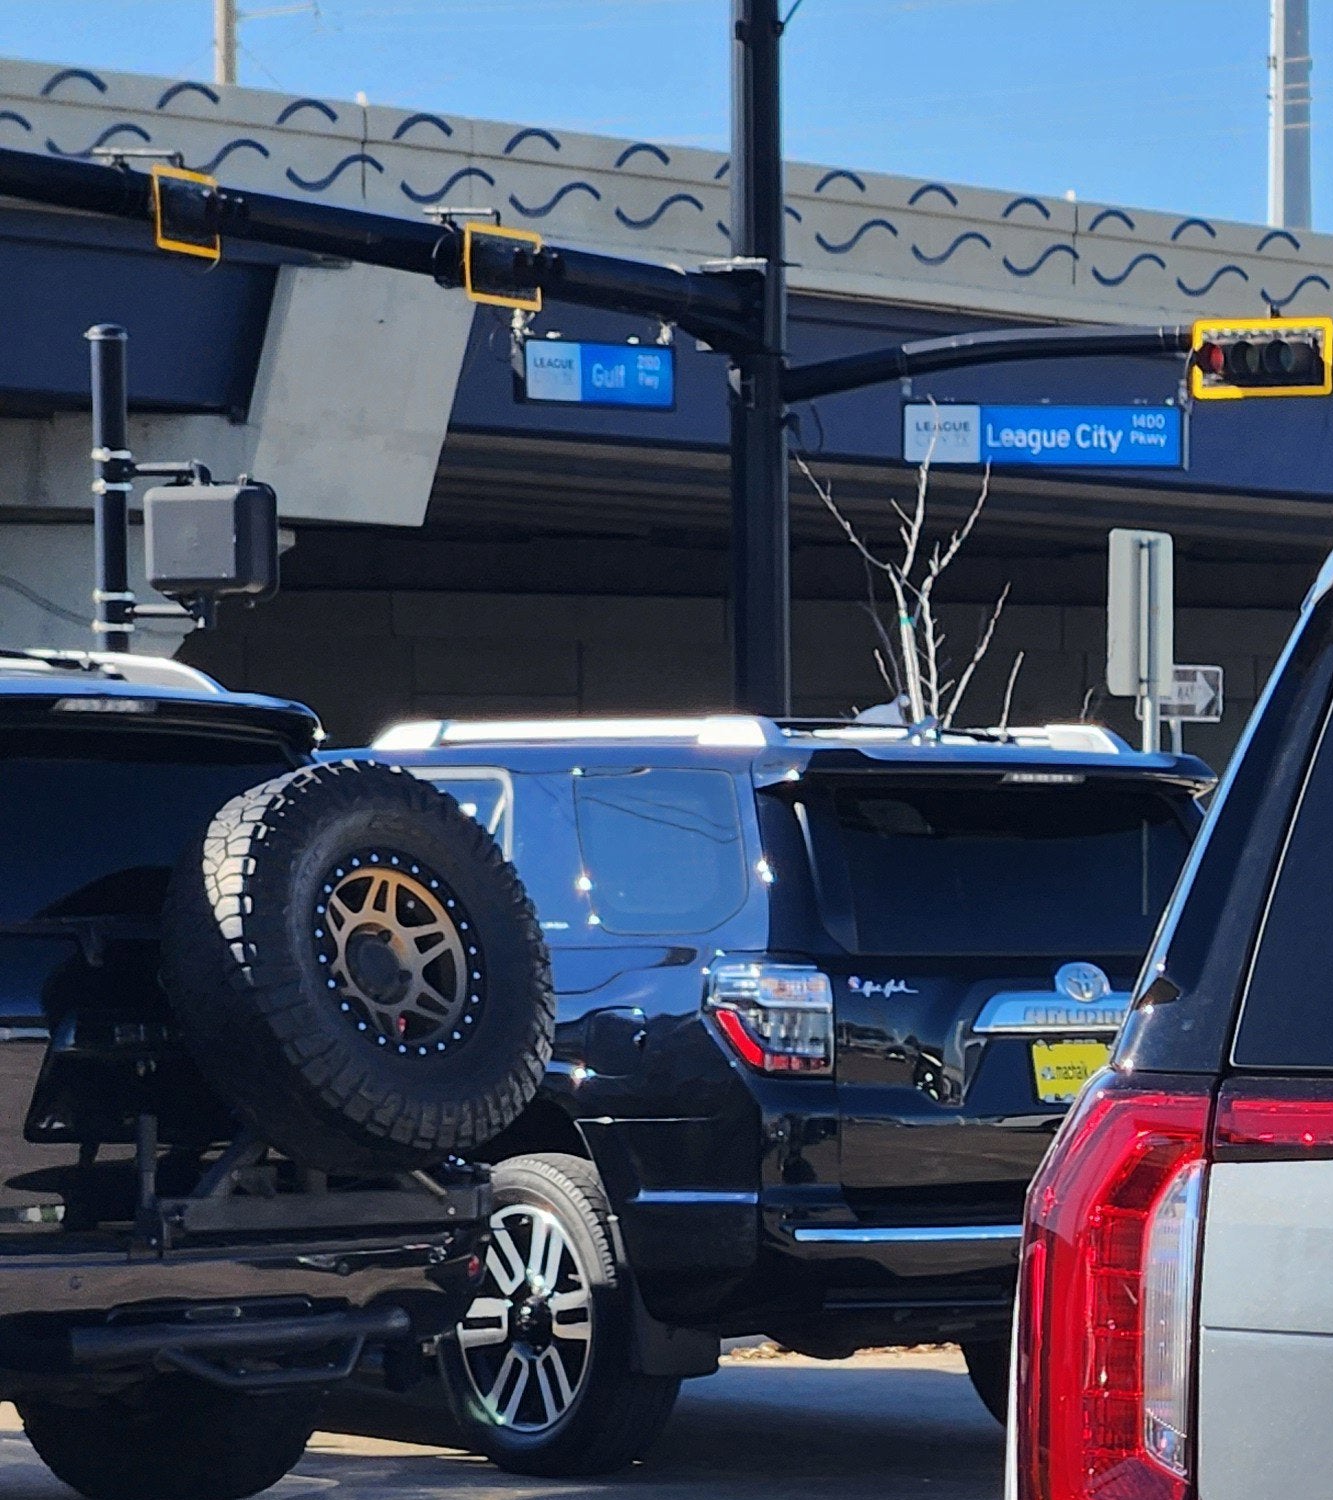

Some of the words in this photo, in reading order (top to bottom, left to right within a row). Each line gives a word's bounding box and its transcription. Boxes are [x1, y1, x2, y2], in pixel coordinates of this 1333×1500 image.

[591, 362, 626, 389] Gulf
[915, 420, 970, 432] LEAGUE
[1131, 413, 1166, 429] 1400
[985, 422, 1071, 455] League
[1075, 422, 1124, 455] City
[1130, 430, 1167, 448] Pkwy
